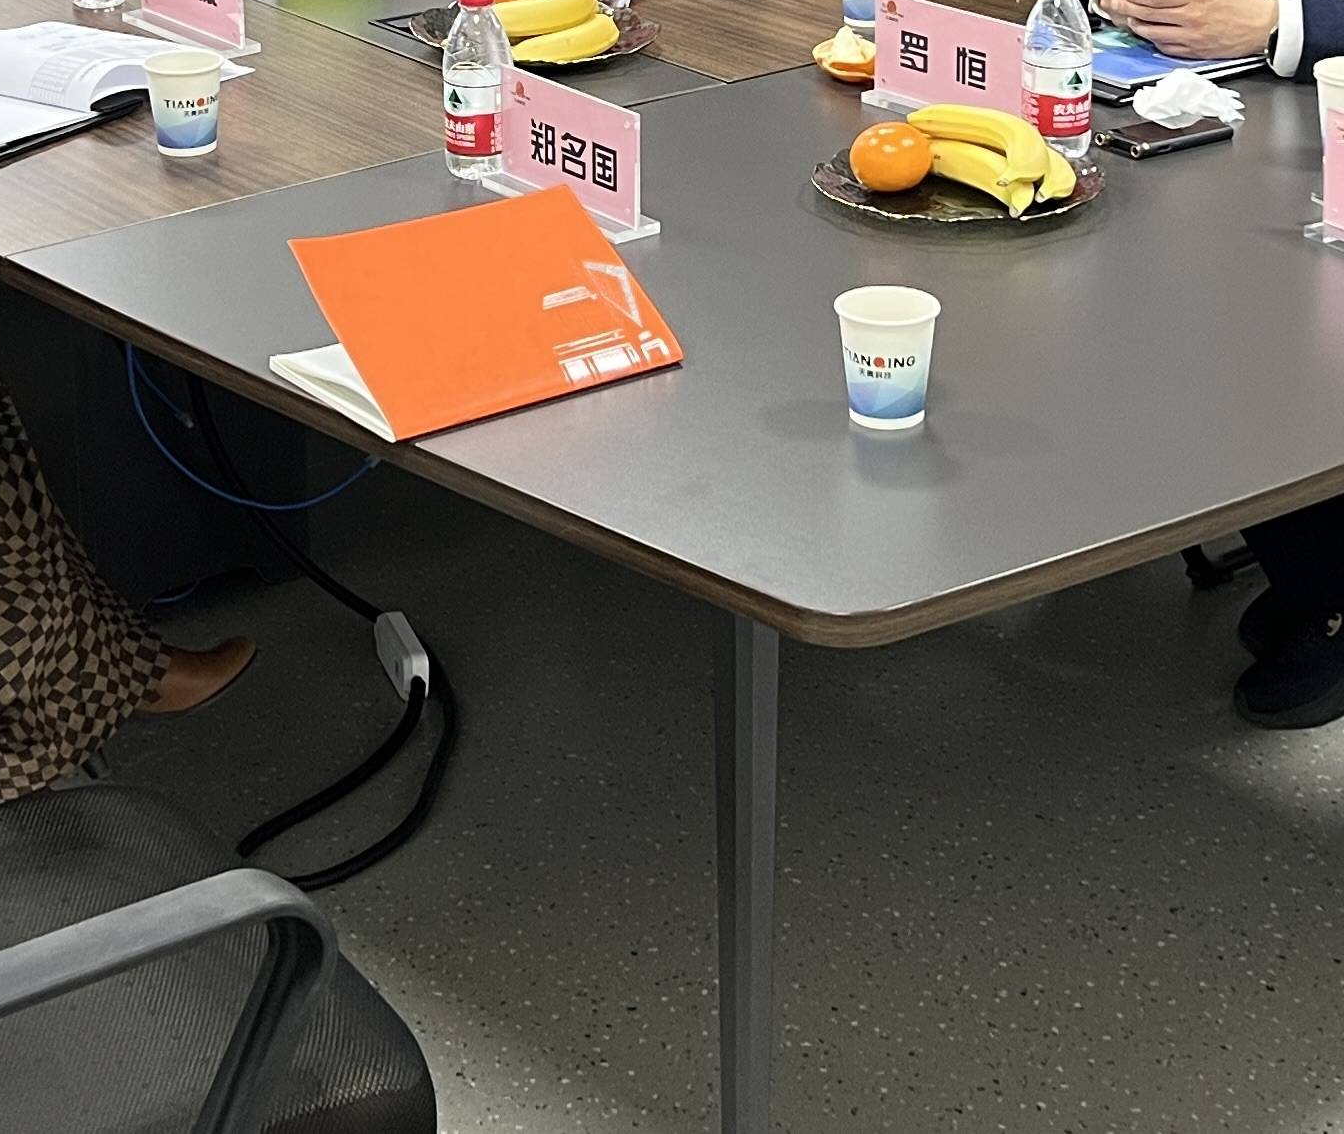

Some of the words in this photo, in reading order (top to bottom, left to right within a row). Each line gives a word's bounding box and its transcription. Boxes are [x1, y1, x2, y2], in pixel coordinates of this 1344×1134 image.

[899, 29, 929, 74] 罗
[956, 46, 987, 91] 恒
[530, 117, 618, 193] 郑名国
